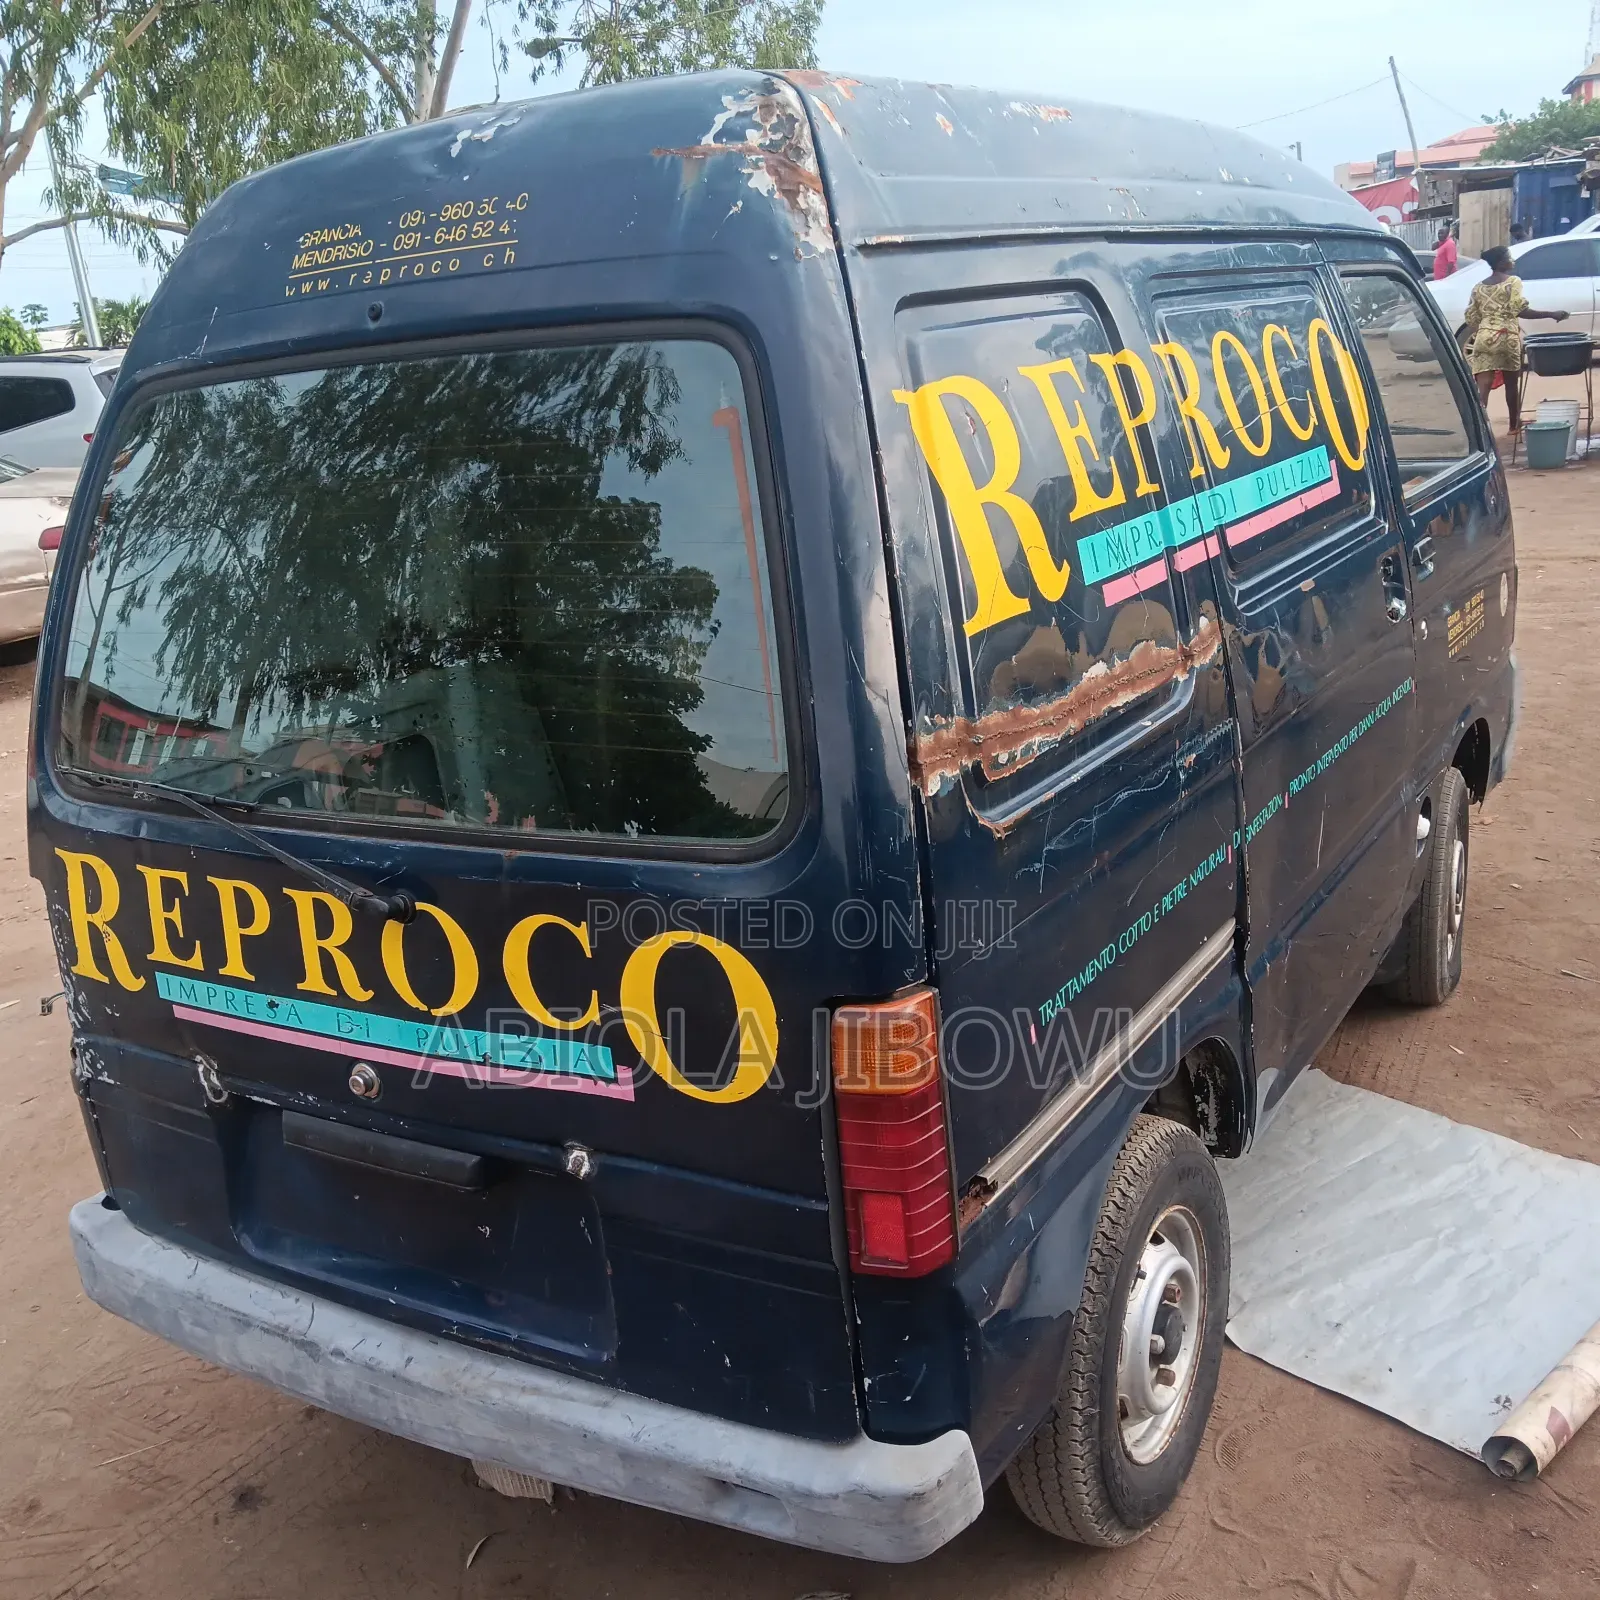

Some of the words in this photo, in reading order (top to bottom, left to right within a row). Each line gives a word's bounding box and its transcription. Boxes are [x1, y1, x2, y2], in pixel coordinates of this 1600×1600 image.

[291, 239, 374, 271] MENDRISIO
[471, 219, 495, 240] 52
[299, 223, 362, 249] GRANCIA
[892, 317, 1370, 638] REPROCO
[1089, 496, 1203, 575] IMPRSA
[1208, 487, 1237, 522] DI
[1255, 452, 1328, 503] PULIZIA
[1038, 942, 1117, 1027] TRATTAMENTO
[1118, 910, 1152, 954] COTTO
[1153, 903, 1160, 924] E
[1161, 877, 1188, 916] PIETRE
[1189, 842, 1227, 889] NATURALI
[1289, 763, 1316, 798] PRONTO
[53, 847, 779, 1104] REPROCO
[164, 976, 304, 1026] IMPRESA
[415, 1026, 597, 1073] PULIZIA
